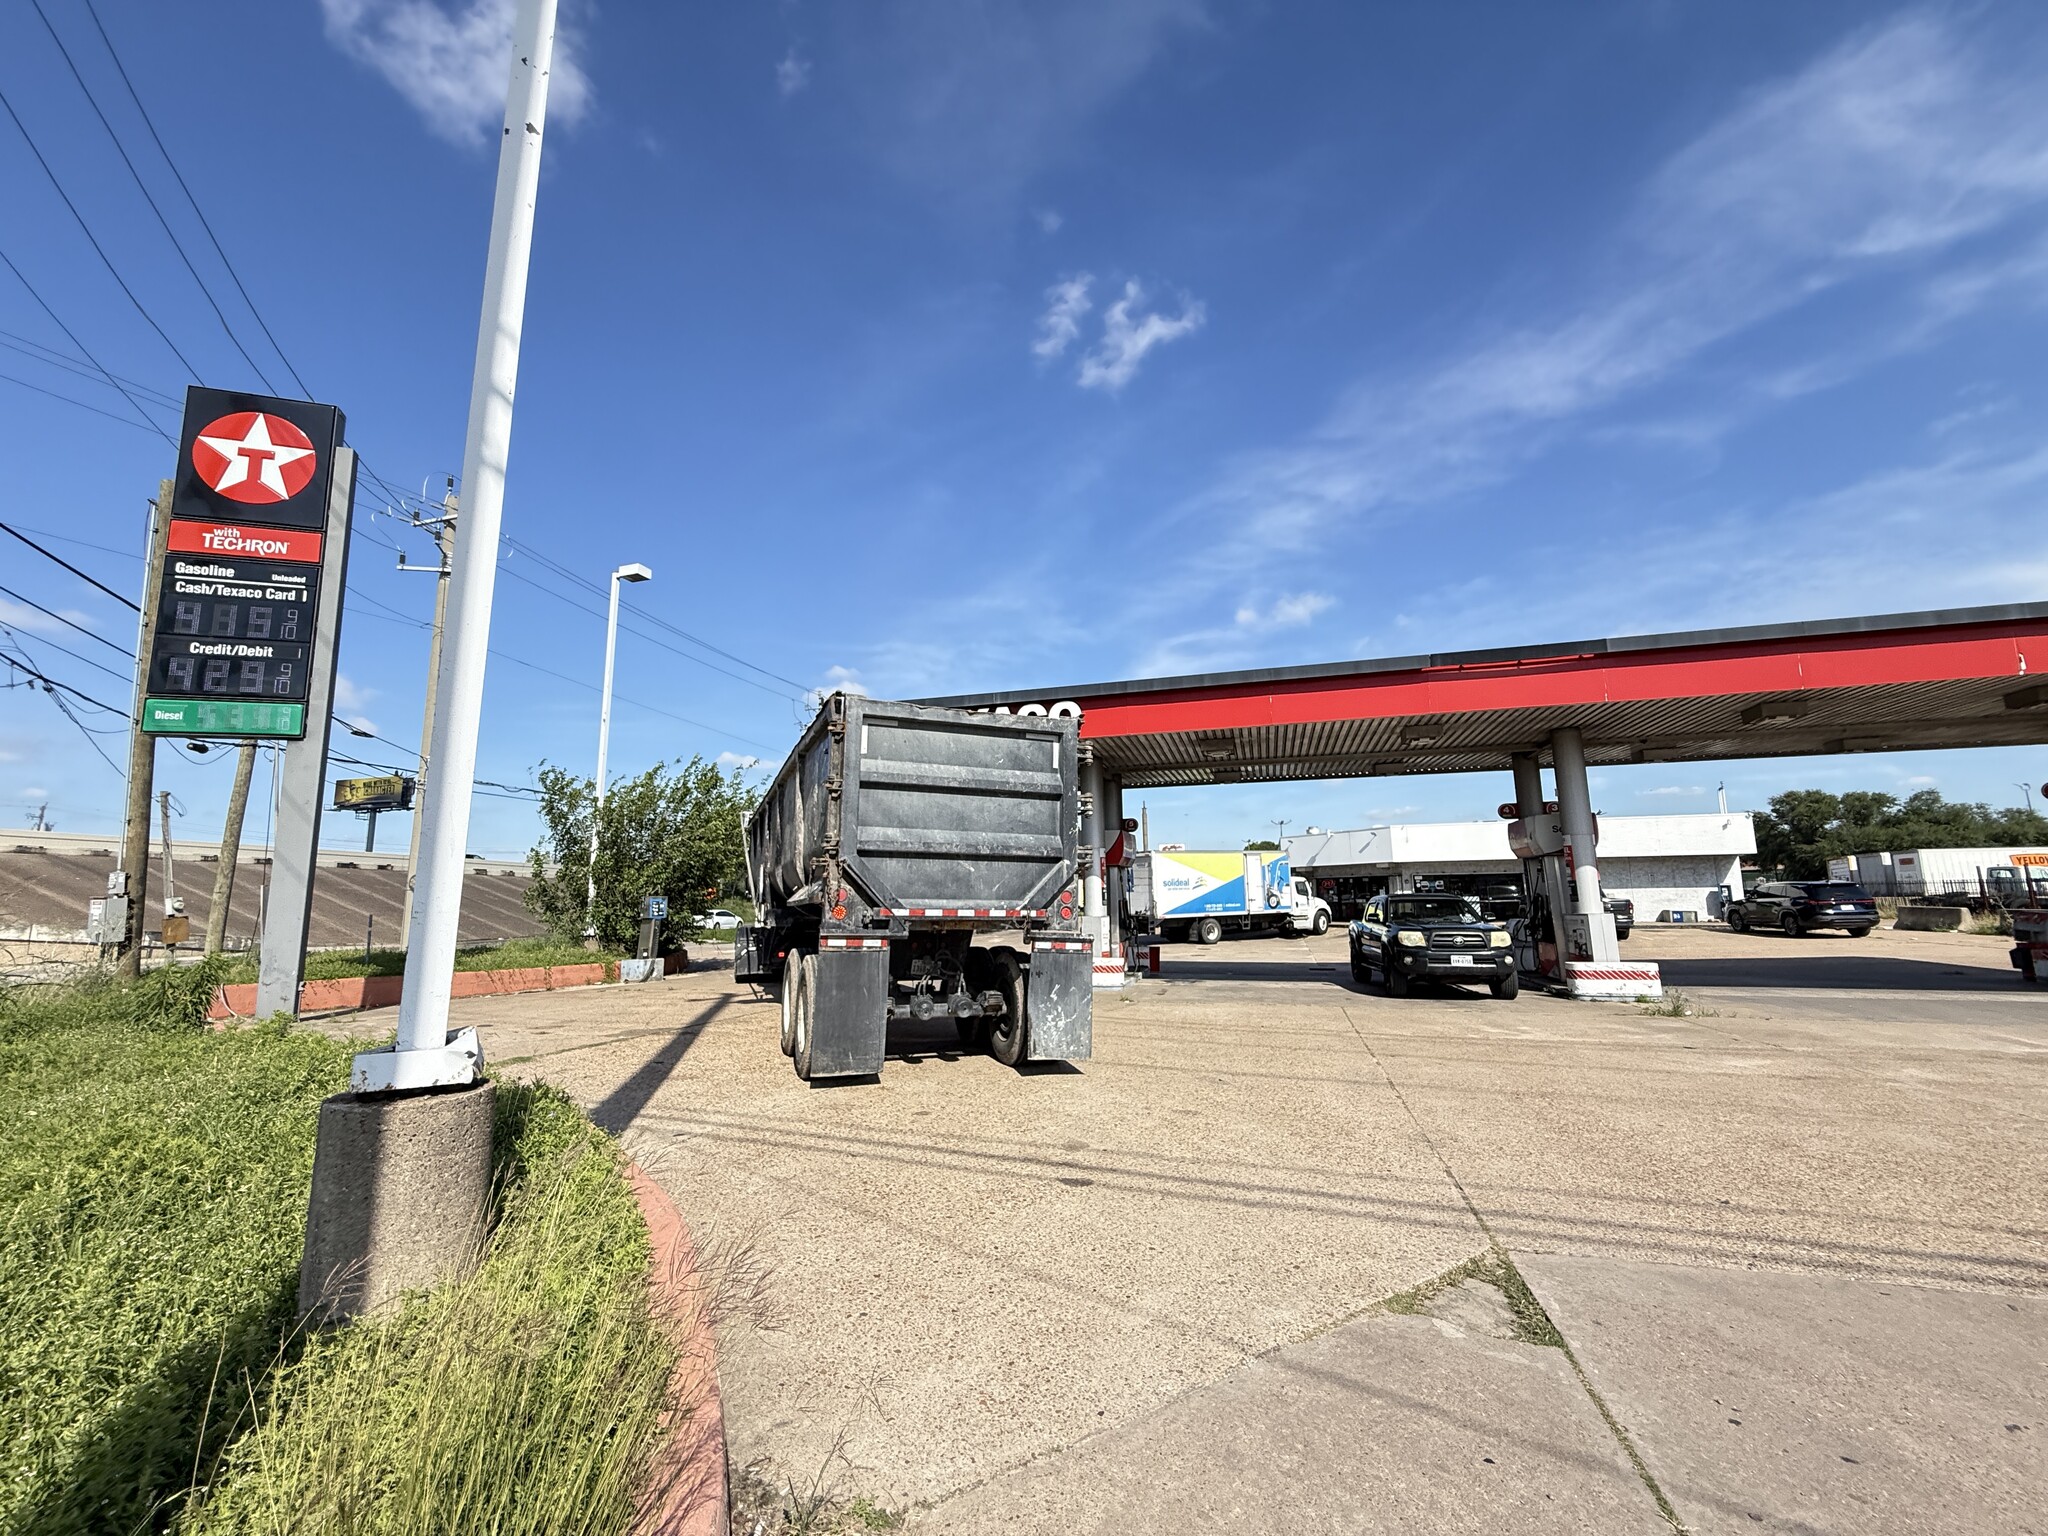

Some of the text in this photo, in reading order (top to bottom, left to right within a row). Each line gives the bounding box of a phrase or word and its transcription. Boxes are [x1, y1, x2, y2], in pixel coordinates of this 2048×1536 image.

[213, 527, 241, 538] with
[202, 532, 288, 556] TECHRON
[175, 562, 235, 578] Gasoline
[272, 574, 306, 583] Unleaded
[175, 581, 296, 601] Cash/Texaco Card
[189, 642, 274, 658] Credit/Debit
[154, 710, 184, 721] Diesel
[2016, 856, 2048, 865] YELLO
[1163, 878, 1190, 887] solideal
